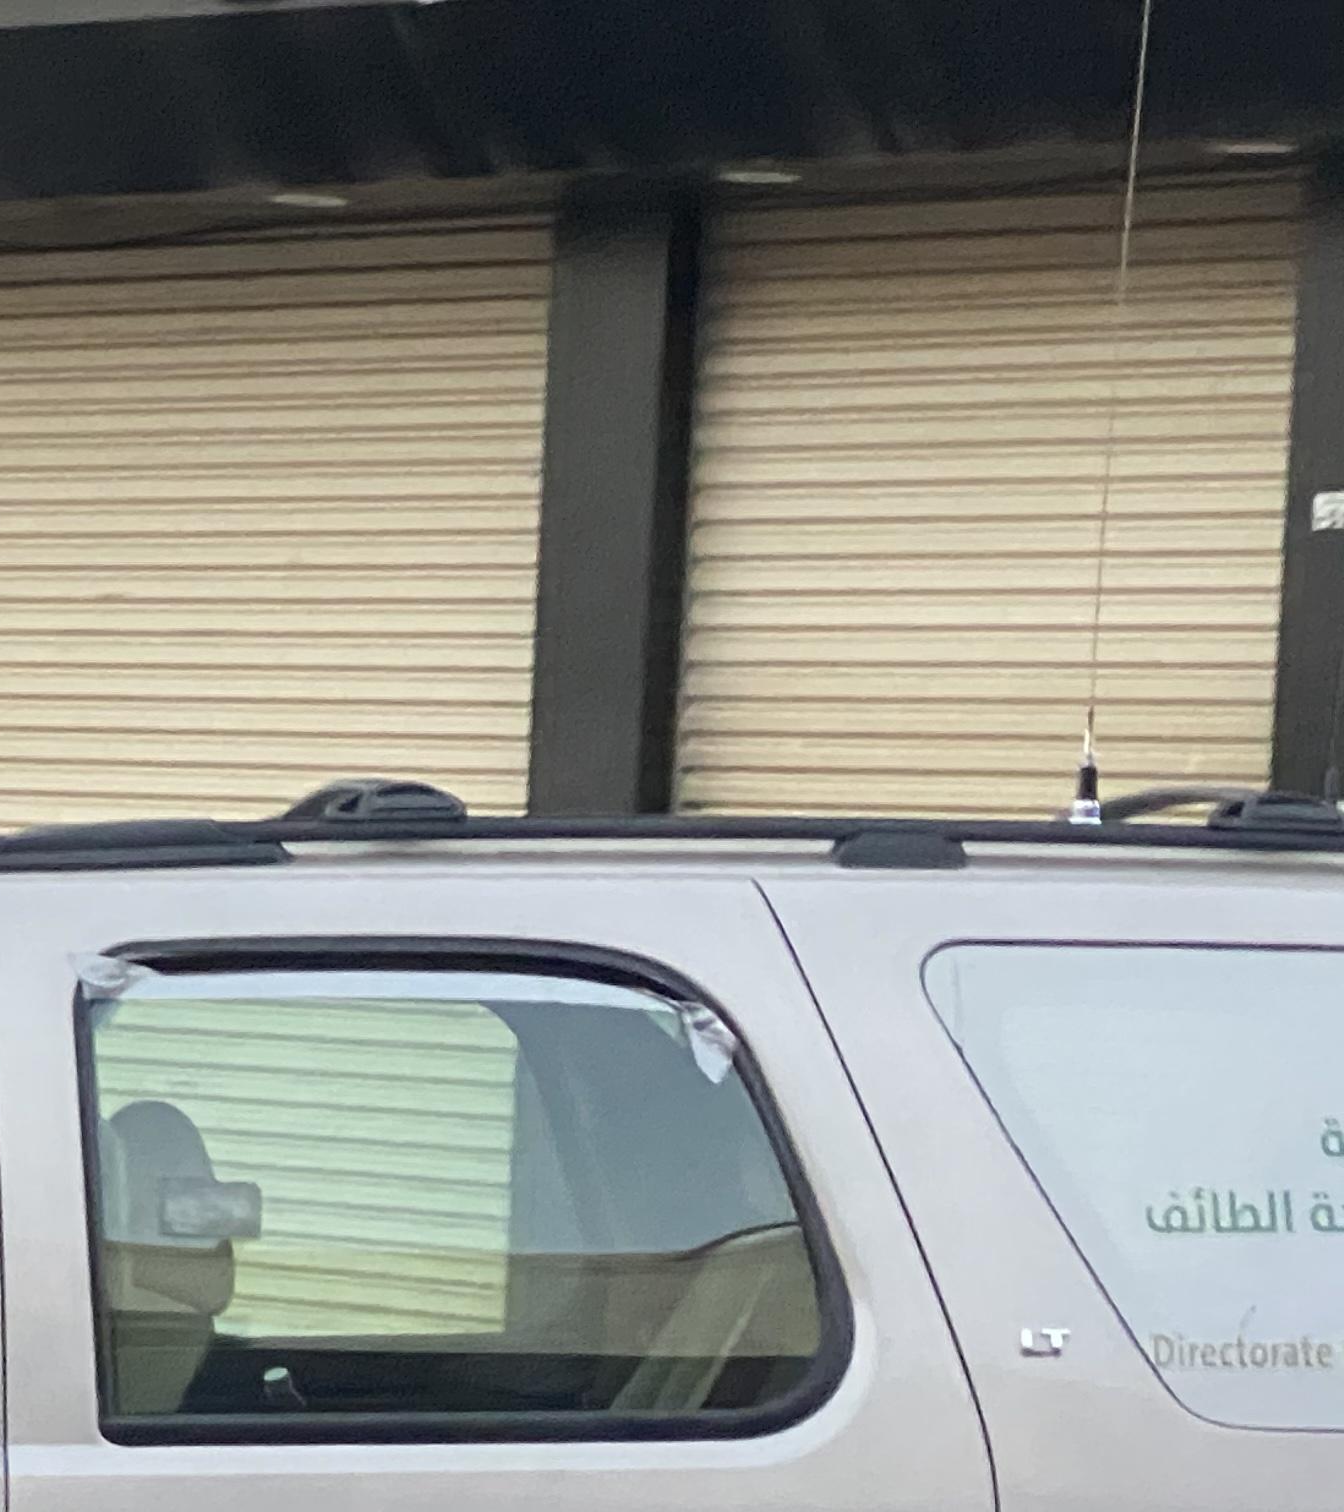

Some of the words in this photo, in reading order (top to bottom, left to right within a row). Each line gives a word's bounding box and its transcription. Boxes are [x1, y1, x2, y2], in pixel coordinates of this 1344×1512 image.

[1144, 1185, 1297, 1235] الطائف
[1018, 1327, 1072, 1358] LT
[1150, 1332, 1334, 1370] Directorate
